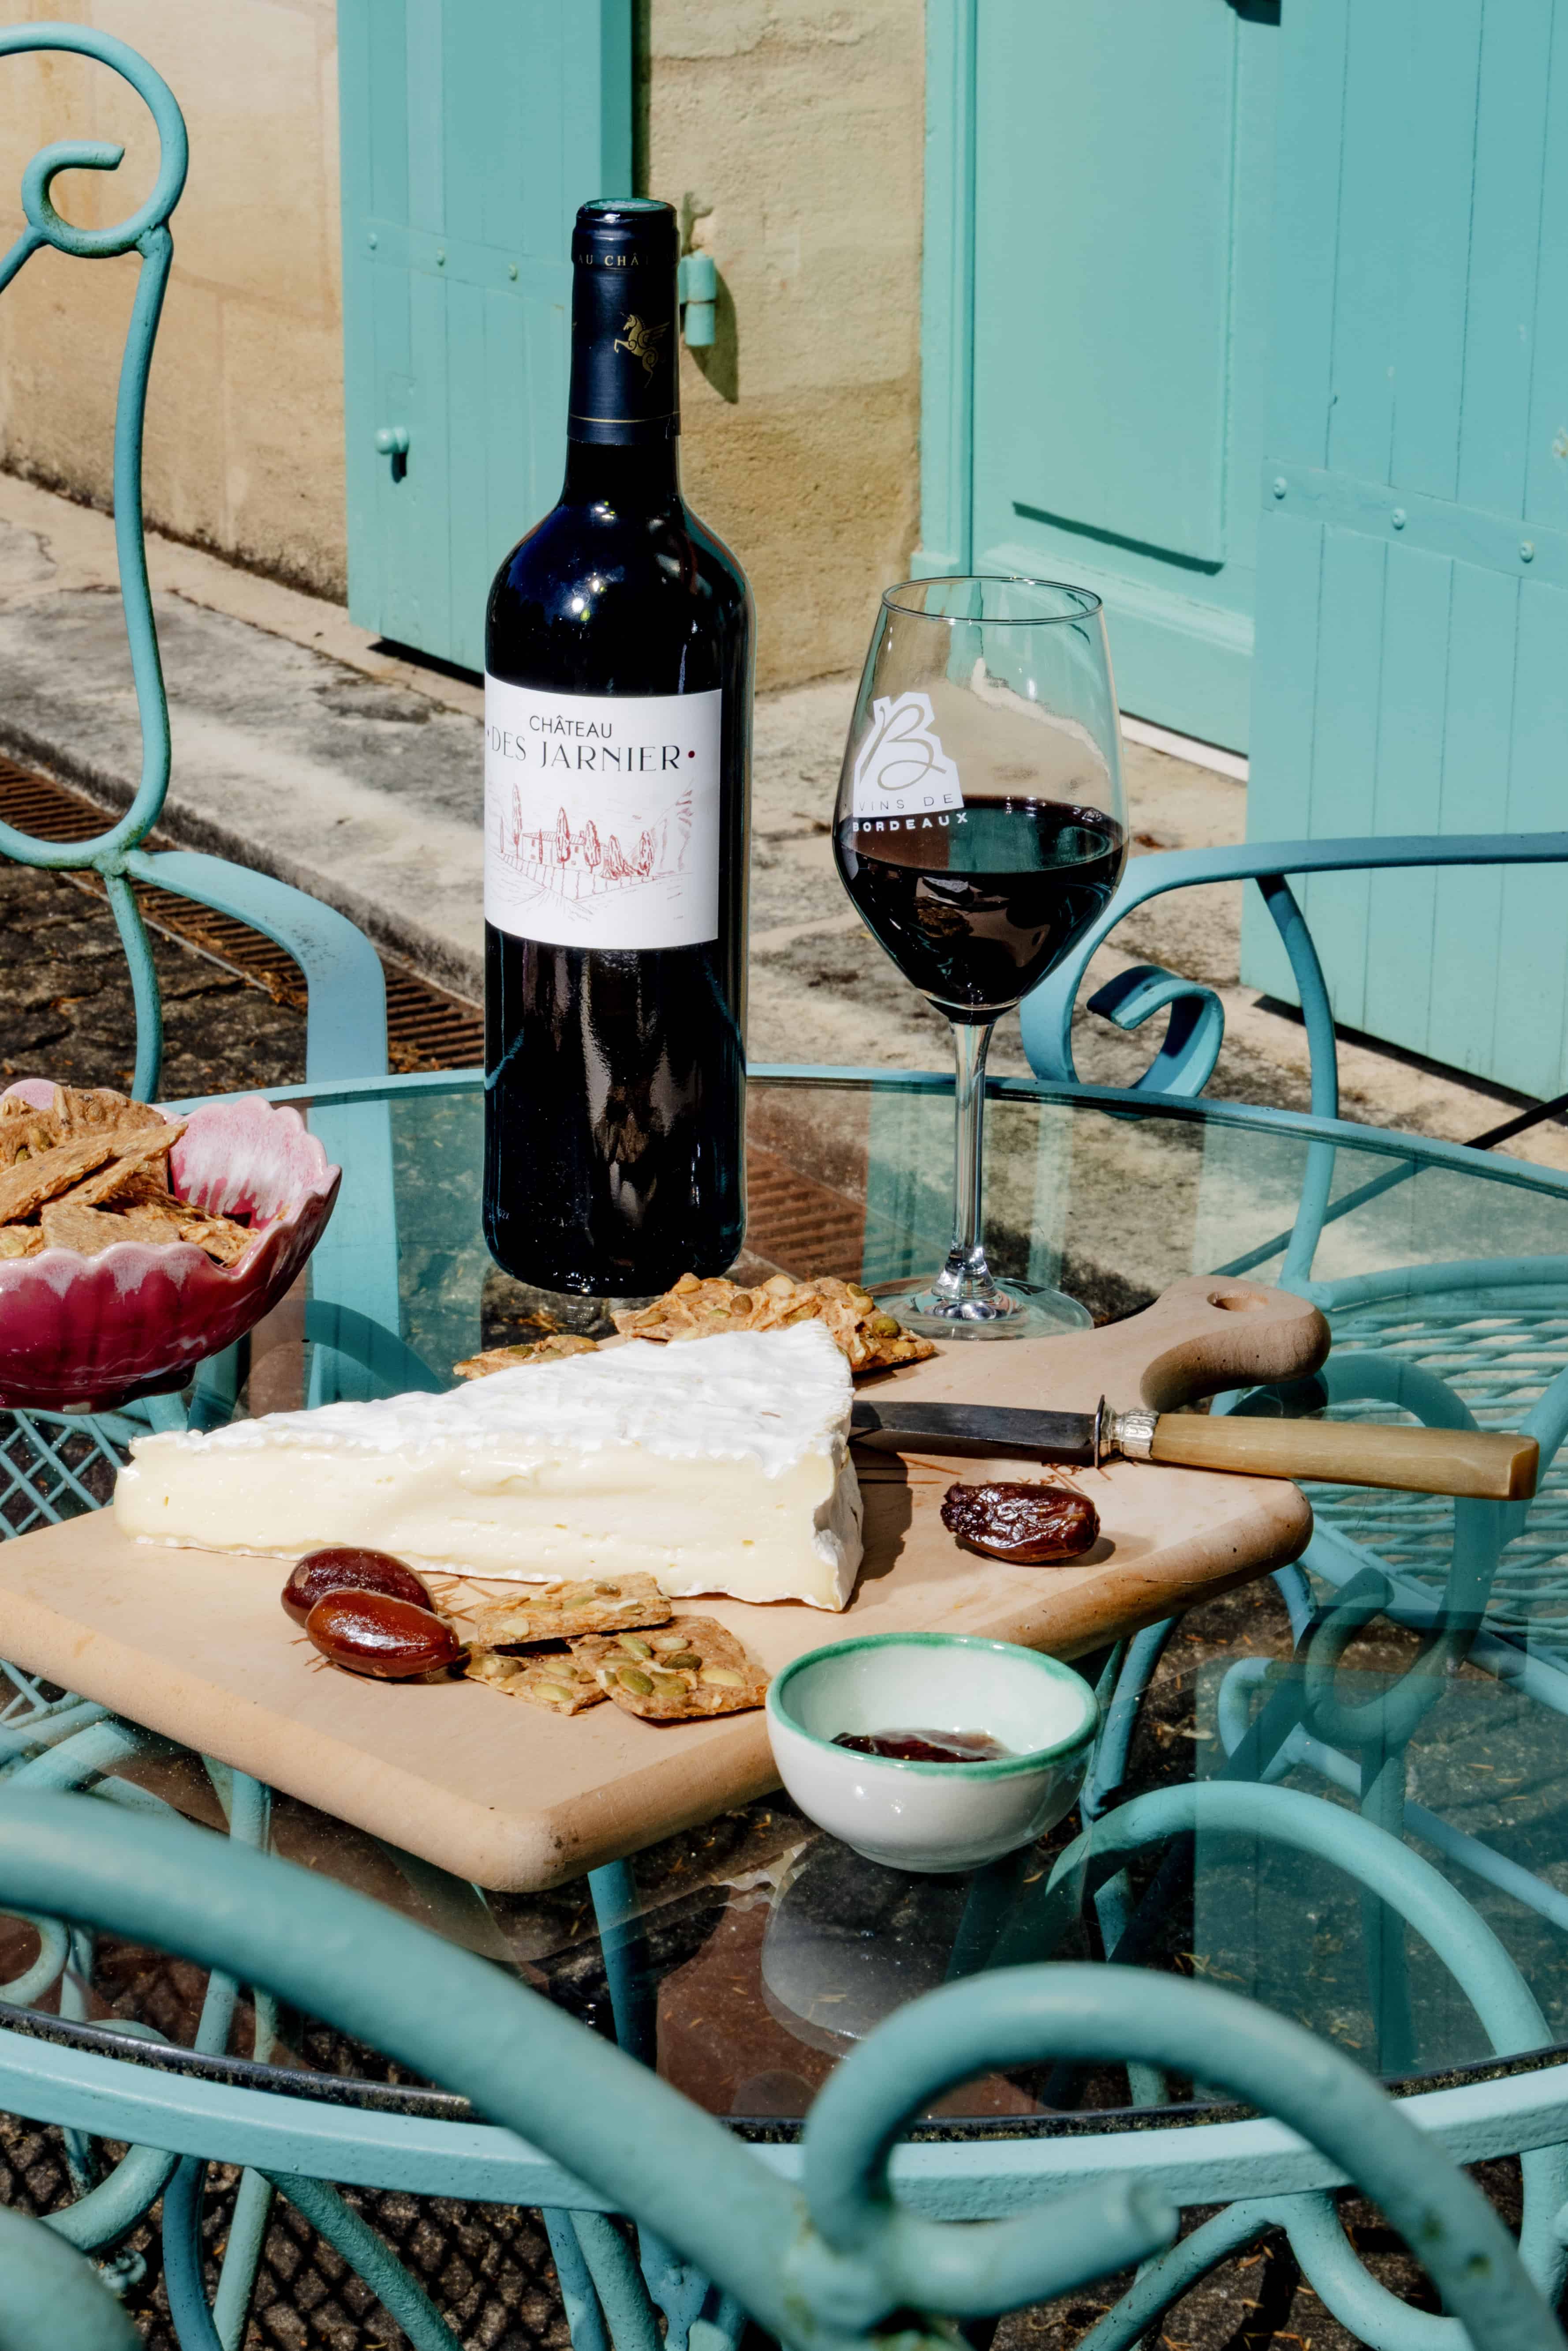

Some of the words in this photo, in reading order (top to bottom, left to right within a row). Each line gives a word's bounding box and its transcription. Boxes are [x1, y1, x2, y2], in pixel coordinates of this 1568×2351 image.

[529, 715, 612, 739] CHÂTEAU
[492, 726, 526, 761] DES
[541, 741, 679, 772] JARNIER
[859, 799, 905, 811] VINS
[923, 794, 953, 806] DE
[852, 813, 967, 832] BORDEAUX
